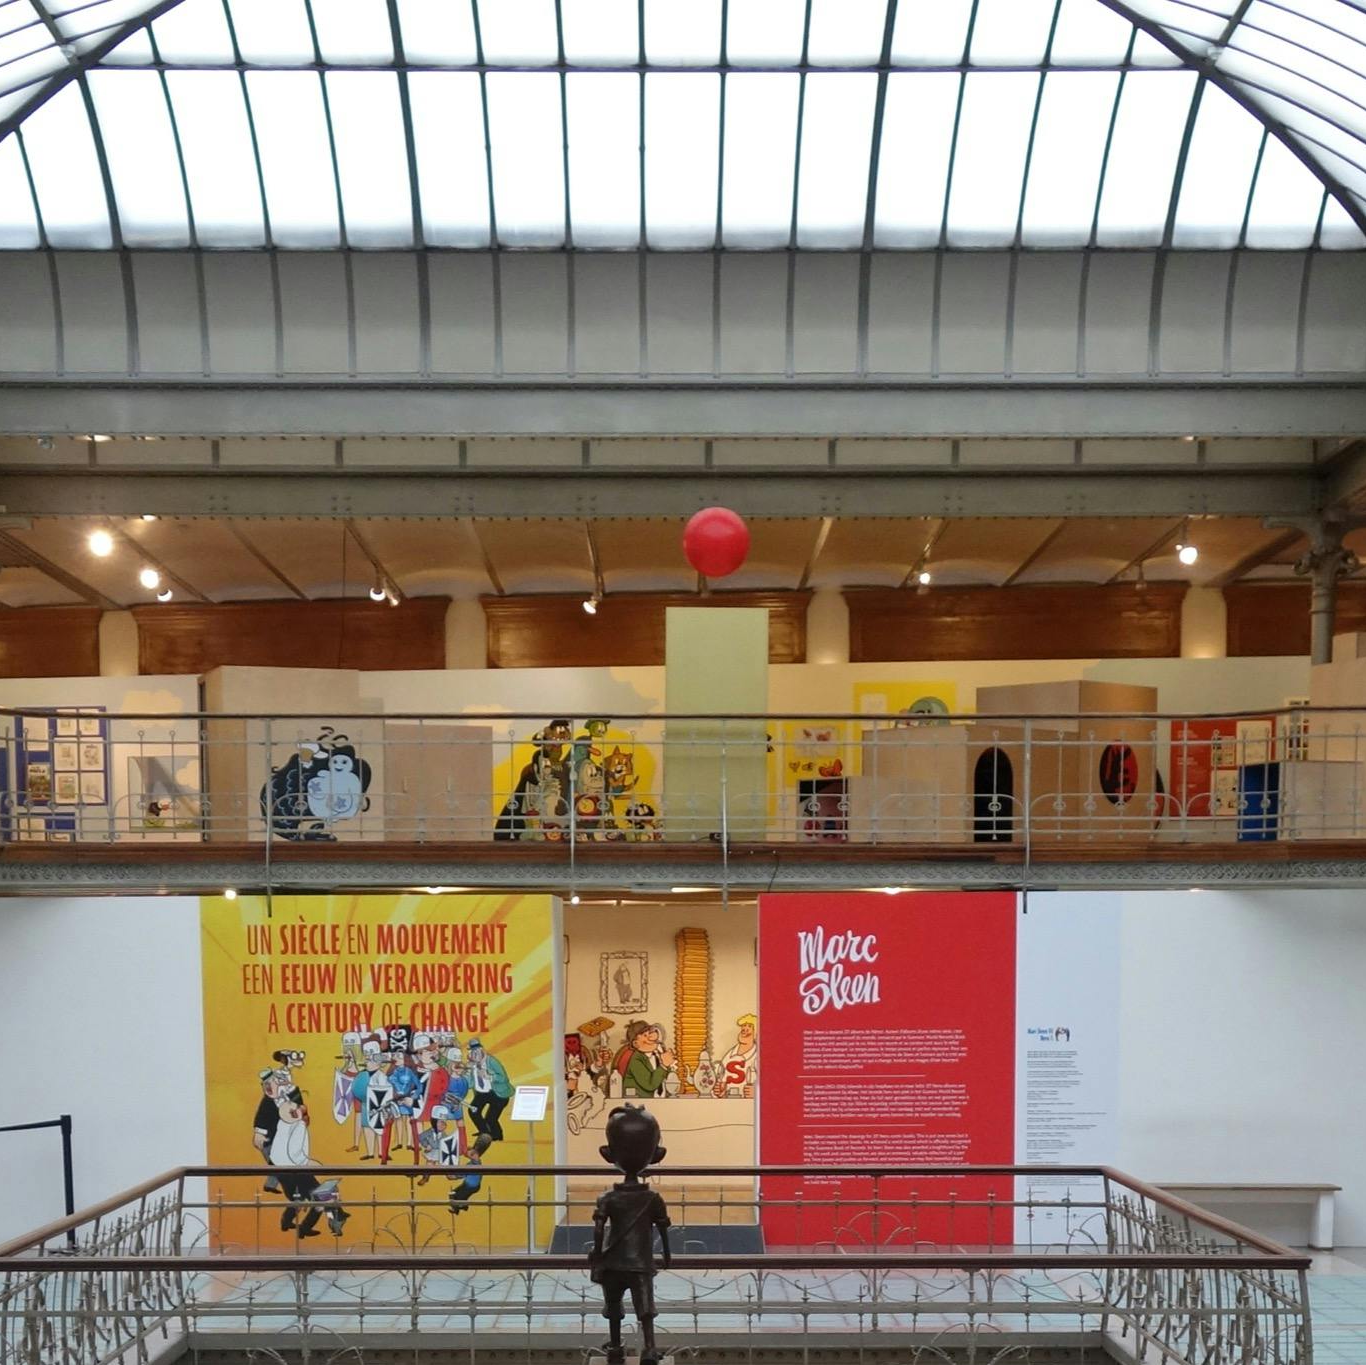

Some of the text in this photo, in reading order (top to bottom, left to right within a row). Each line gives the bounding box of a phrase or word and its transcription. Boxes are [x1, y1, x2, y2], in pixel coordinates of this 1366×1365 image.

[247, 916, 507, 955] UN SIÈCLE EN MOUVEMENT
[798, 925, 879, 975] Marc
[243, 963, 513, 995] EEN EEUW IN VERANDERING
[799, 963, 881, 1015] Sleen
[268, 1002, 490, 1034] A CENTURY OF CHANGE
